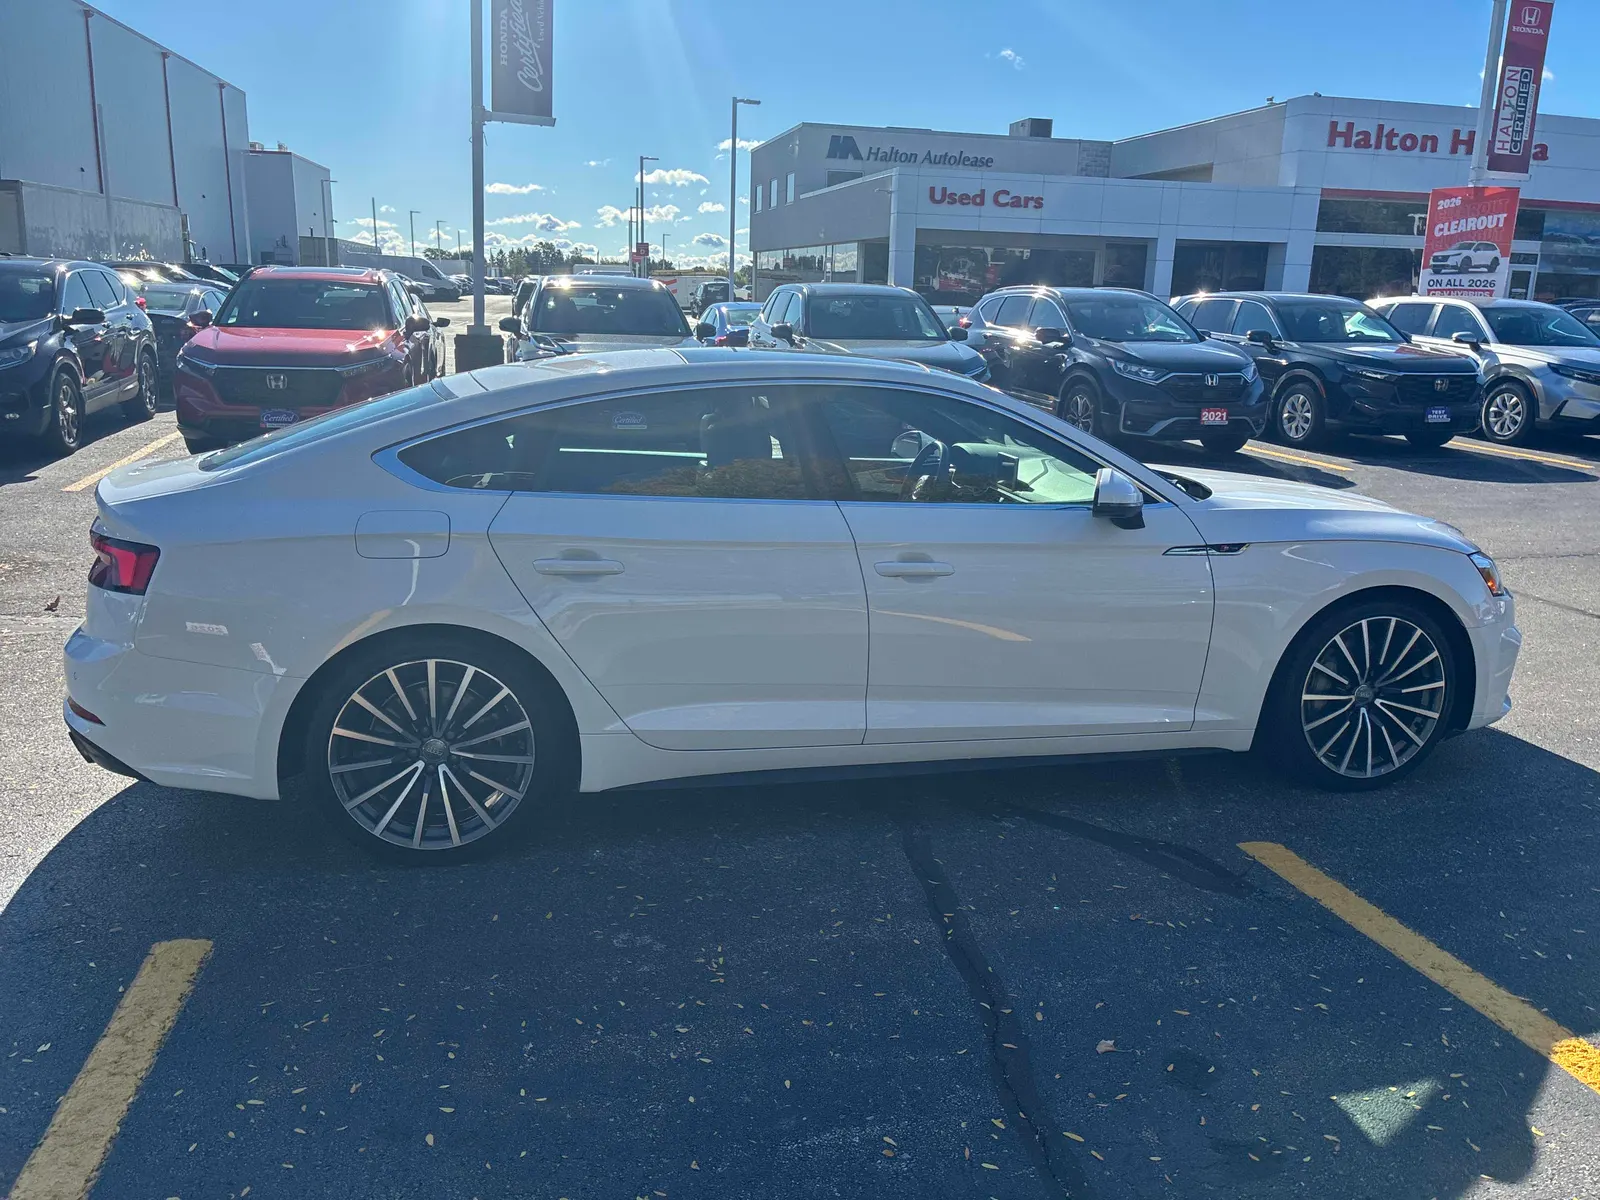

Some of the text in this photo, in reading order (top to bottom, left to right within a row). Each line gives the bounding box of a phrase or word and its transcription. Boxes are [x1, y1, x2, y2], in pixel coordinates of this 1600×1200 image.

[500, 8, 508, 66] HONDA
[1512, 25, 1545, 35] HONDA
[1496, 68, 1521, 151] HALTON
[1510, 69, 1533, 154] CERTIFIED
[1327, 120, 1439, 153] Halton
[866, 146, 994, 168] Halton Autolease
[929, 186, 1044, 209] Used Cars
[1437, 196, 1462, 210] 2026
[1433, 213, 1508, 237] CLEAROUT
[1427, 279, 1496, 288] ON ALL 2026
[263, 413, 295, 422] Certified
[1202, 411, 1227, 421] 2021
